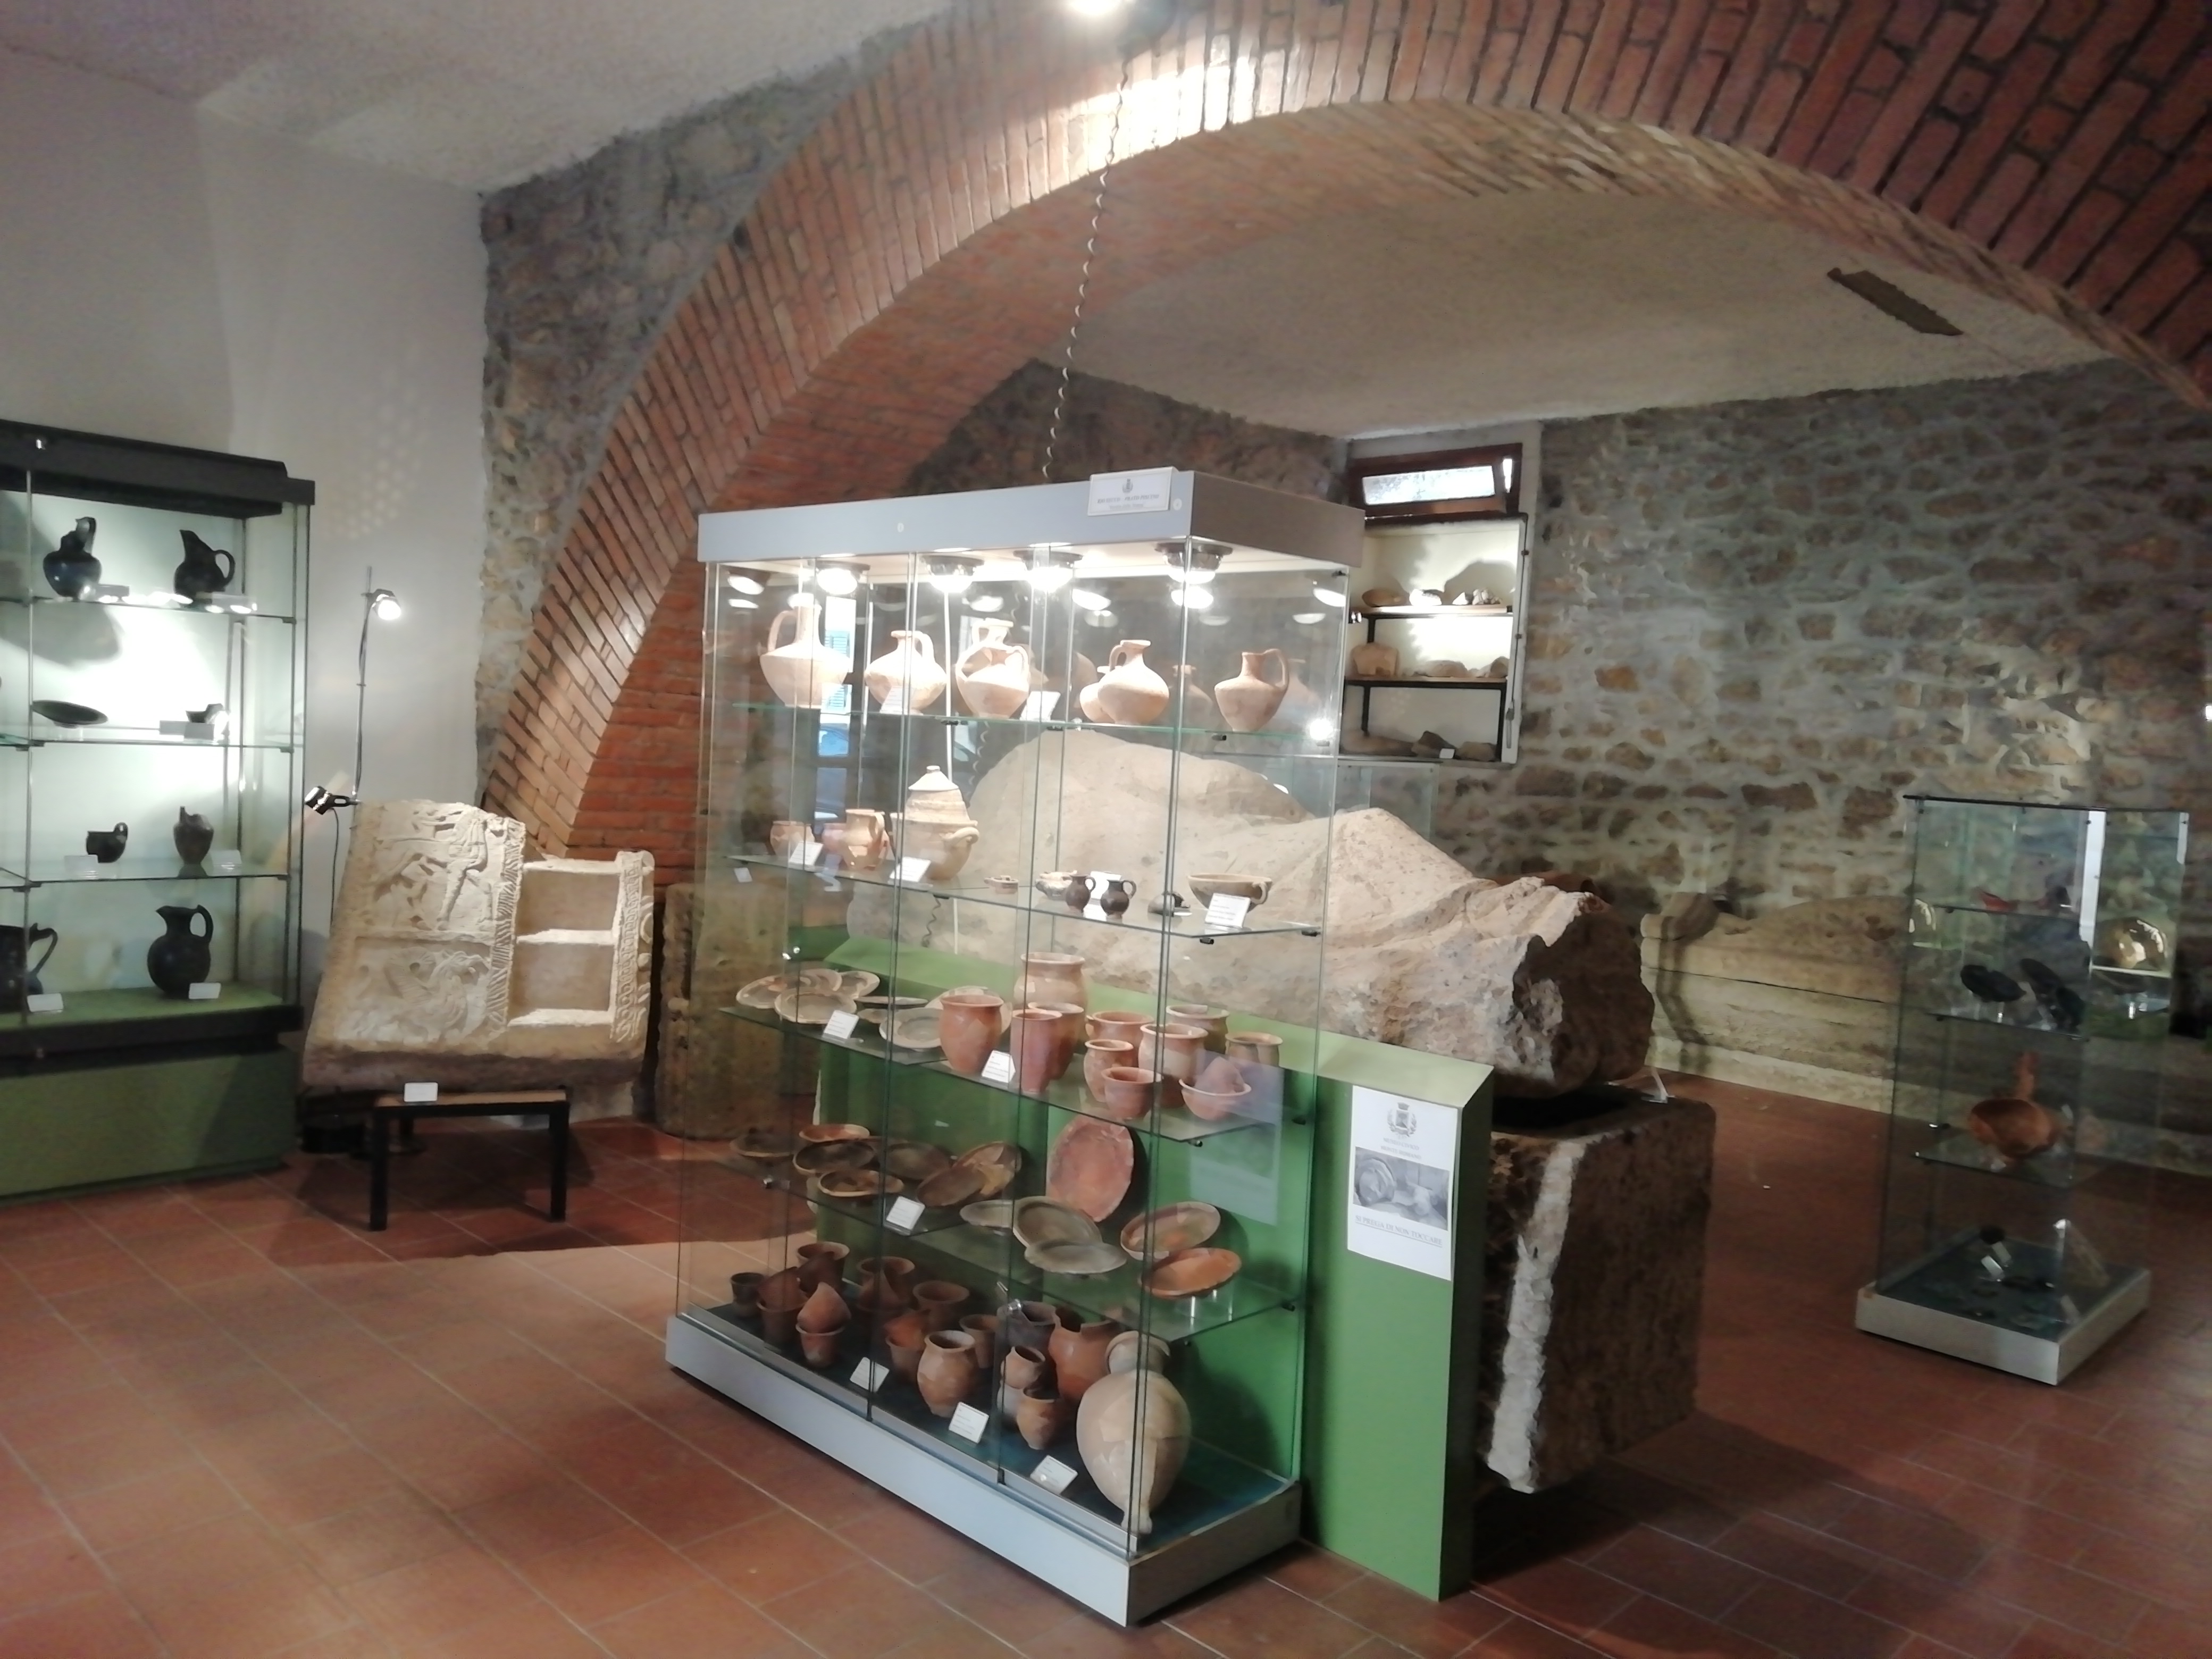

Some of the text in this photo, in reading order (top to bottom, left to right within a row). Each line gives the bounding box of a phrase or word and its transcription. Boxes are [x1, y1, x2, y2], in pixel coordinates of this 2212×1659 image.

[1383, 1137, 1420, 1151] MUSEO CIVICO
[1362, 1217, 1385, 1228] PREGA
[1386, 1222, 1394, 1231] DI
[1395, 1226, 1409, 1235] NON
[1411, 1230, 1443, 1246] TOCCARE
